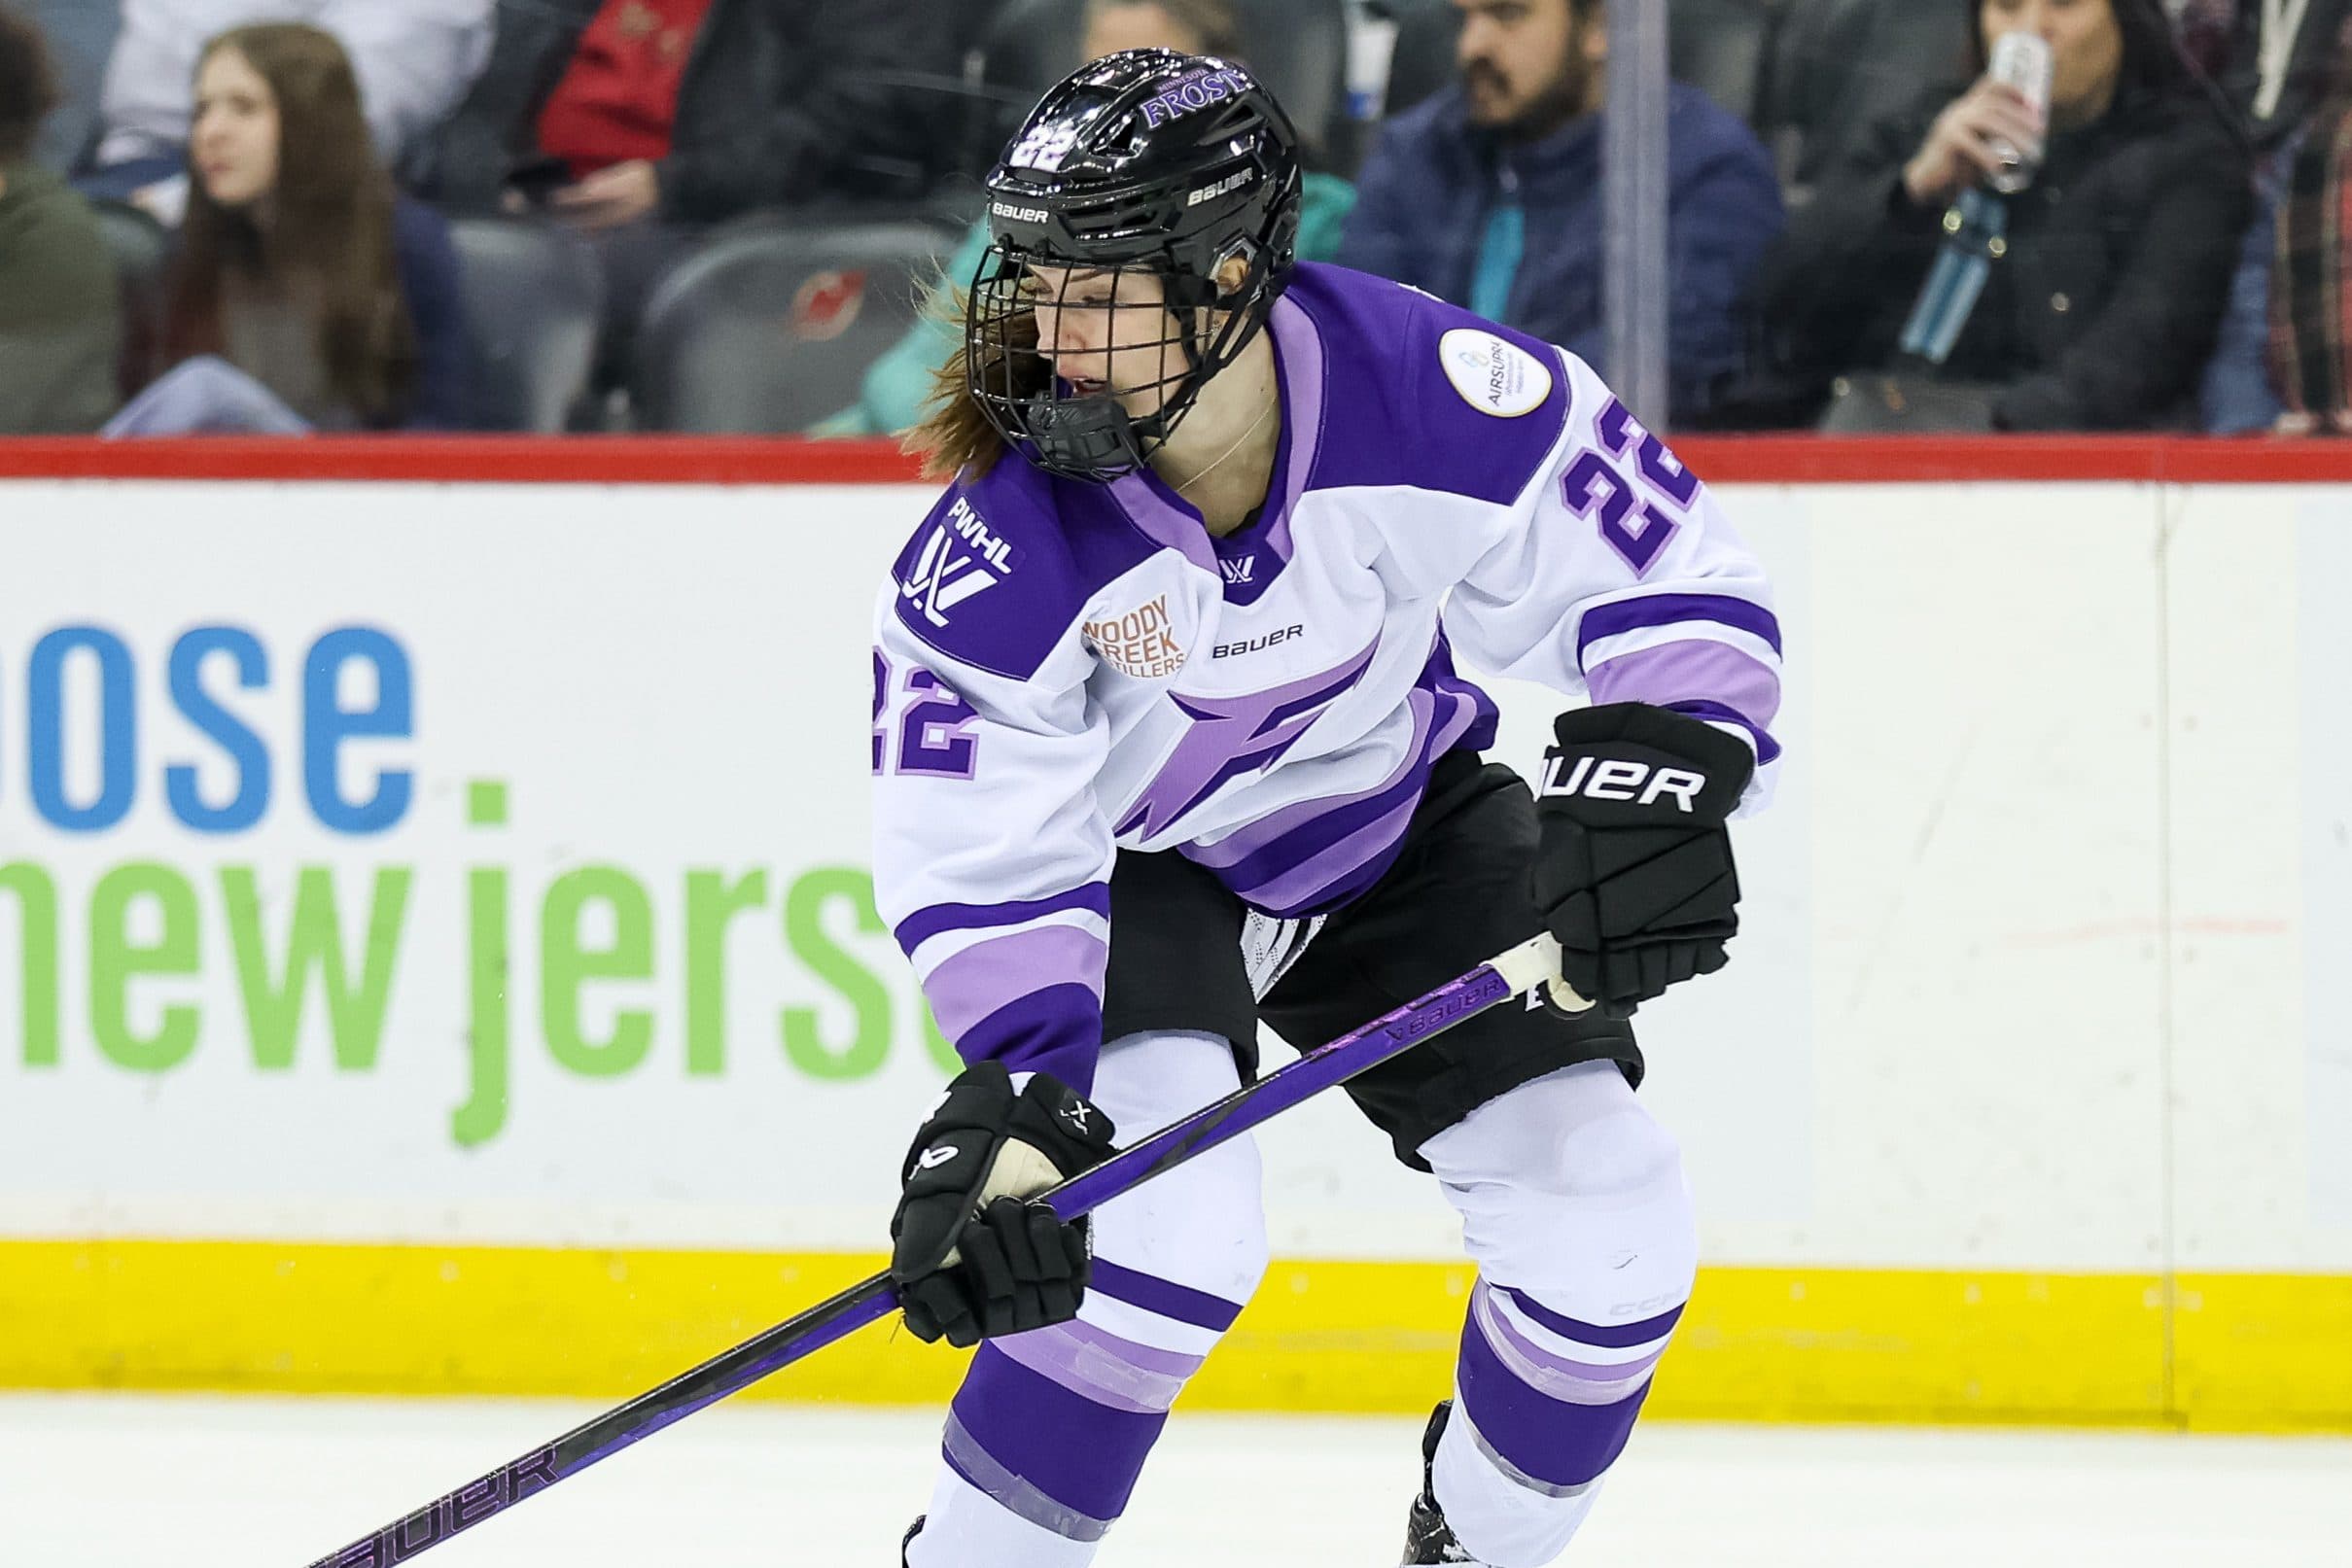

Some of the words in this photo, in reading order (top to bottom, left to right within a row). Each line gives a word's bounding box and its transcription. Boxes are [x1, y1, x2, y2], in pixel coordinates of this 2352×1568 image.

[1140, 69, 1251, 128] FROST
[1009, 118, 1076, 173] 22
[993, 202, 1049, 224] BAUER
[1187, 167, 1253, 207] BAUER
[1559, 372, 1703, 580] 22
[947, 496, 1012, 574] PWHL
[1093, 626, 1180, 664] REEK
[1212, 624, 1303, 658] BAUER
[872, 645, 980, 781] 2
[1540, 754, 1706, 813] UER
[448, 782, 966, 1149] jers
